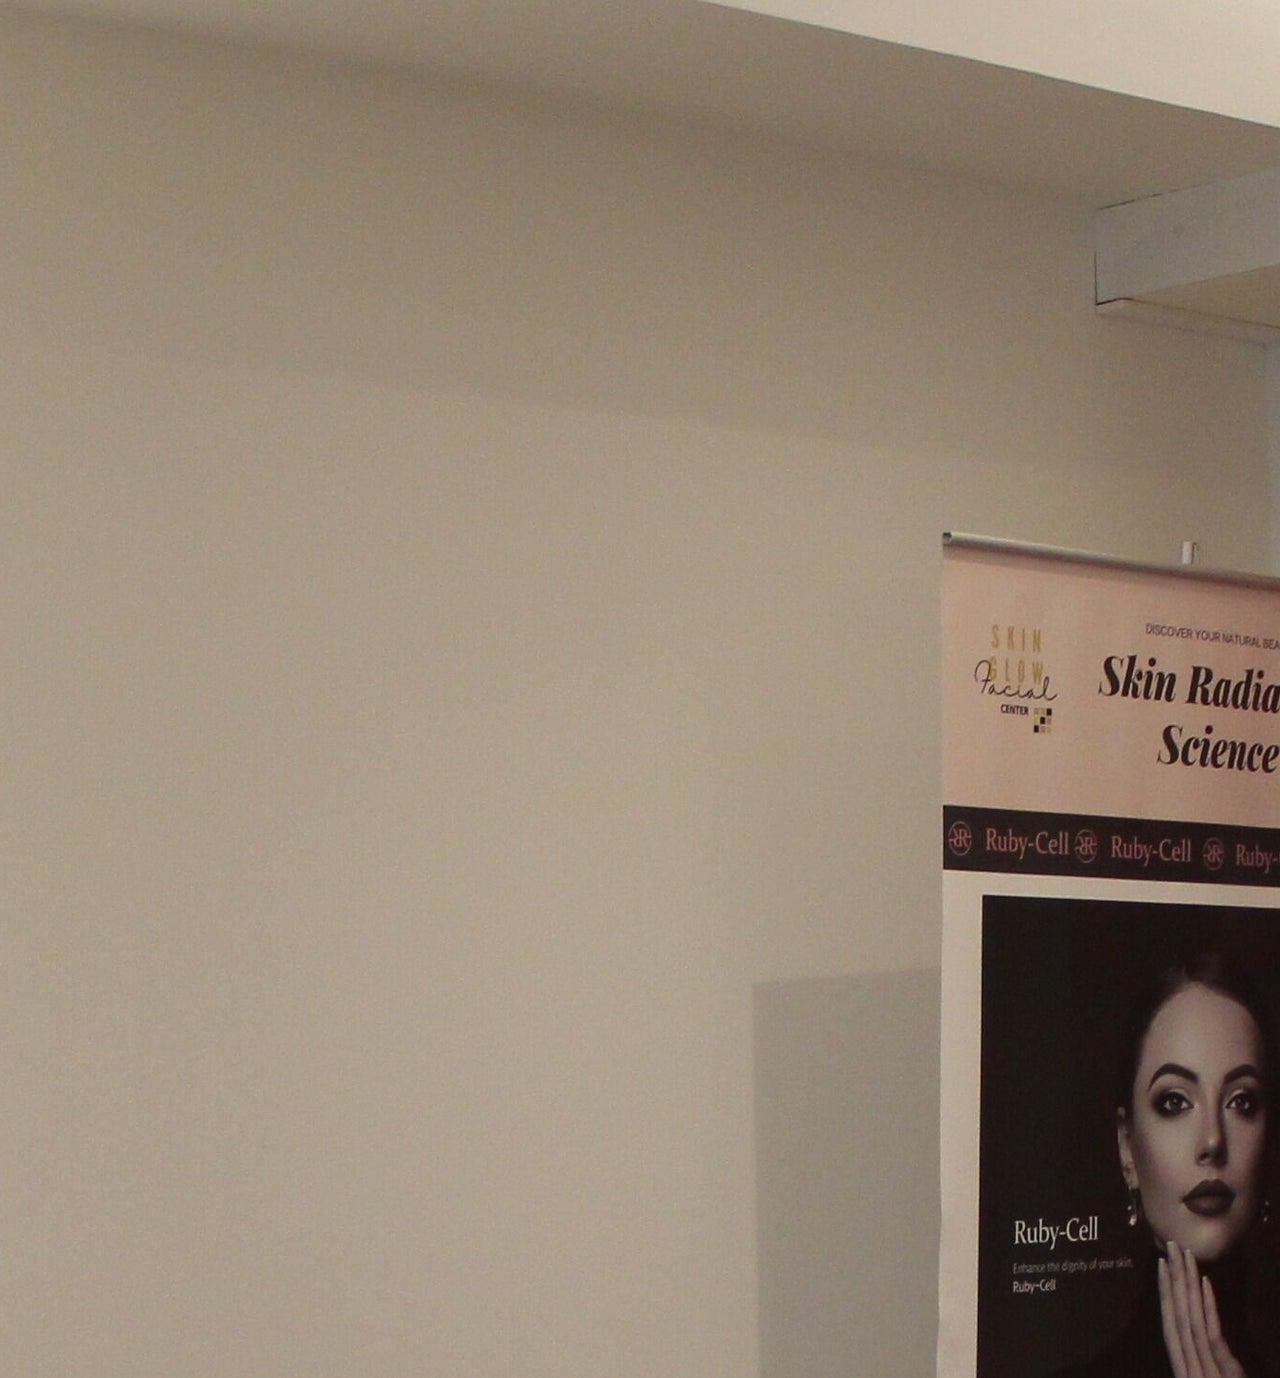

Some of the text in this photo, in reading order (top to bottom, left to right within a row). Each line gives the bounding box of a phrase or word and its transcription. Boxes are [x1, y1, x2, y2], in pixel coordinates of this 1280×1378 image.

[992, 624, 1041, 652] SKIN
[1145, 623, 1193, 639] DISCOVER
[1195, 628, 1221, 642] YOUR
[1222, 632, 1261, 648] NATURAL
[974, 659, 1058, 701] Facial
[990, 656, 1043, 684] GLOW
[1098, 655, 1177, 703] Skin
[1001, 704, 1029, 716] CENTER
[1157, 724, 1280, 774] Science
[986, 828, 1069, 860] Ruby-Cell
[1111, 836, 1191, 867] Ruby-Cell
[1014, 1216, 1099, 1250] Ruby-Cell
[1013, 1262, 1046, 1274] Enhance
[1047, 1261, 1061, 1272] the
[1061, 1259, 1087, 1273] dignity
[1088, 1259, 1097, 1270] of
[1098, 1260, 1114, 1271] your
[1013, 1279, 1056, 1294] Ruby-Cell
